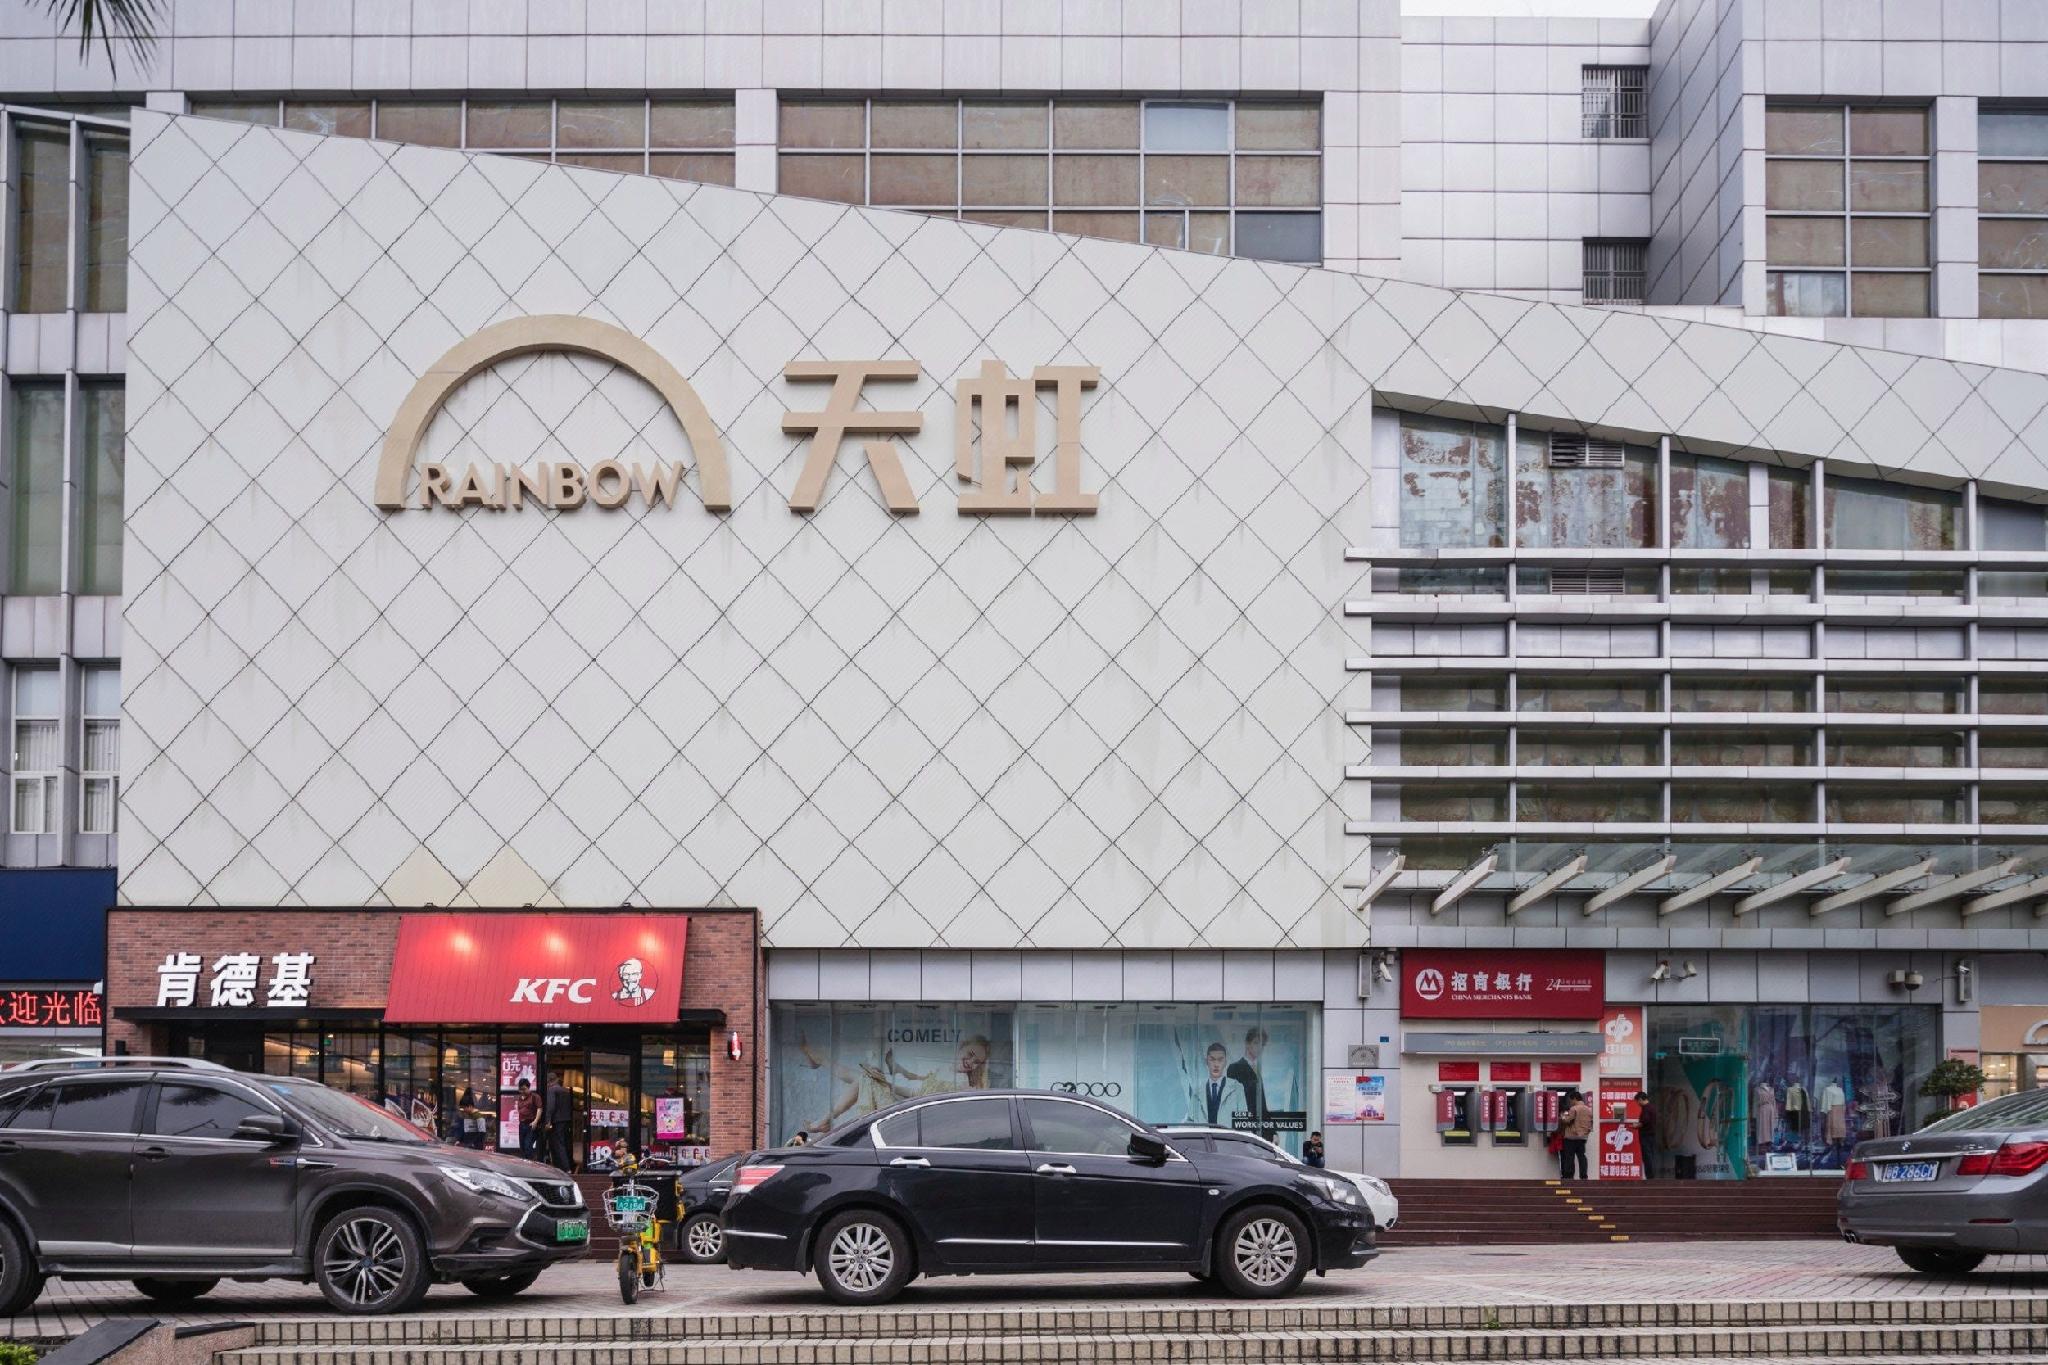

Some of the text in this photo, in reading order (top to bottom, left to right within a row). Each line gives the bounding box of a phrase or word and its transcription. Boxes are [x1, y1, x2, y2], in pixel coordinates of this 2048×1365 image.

[782, 359, 1101, 514] 天虹
[419, 459, 684, 510] RAINBOW
[156, 952, 315, 1007] 肯德基
[509, 978, 597, 1004] KFC
[542, 1035, 570, 1046] KFC
[887, 1029, 962, 1043] COMELY
[1050, 1082, 1122, 1098] G2000
[1234, 1121, 1257, 1129] WORK
[1275, 1121, 1304, 1129] VALUES
